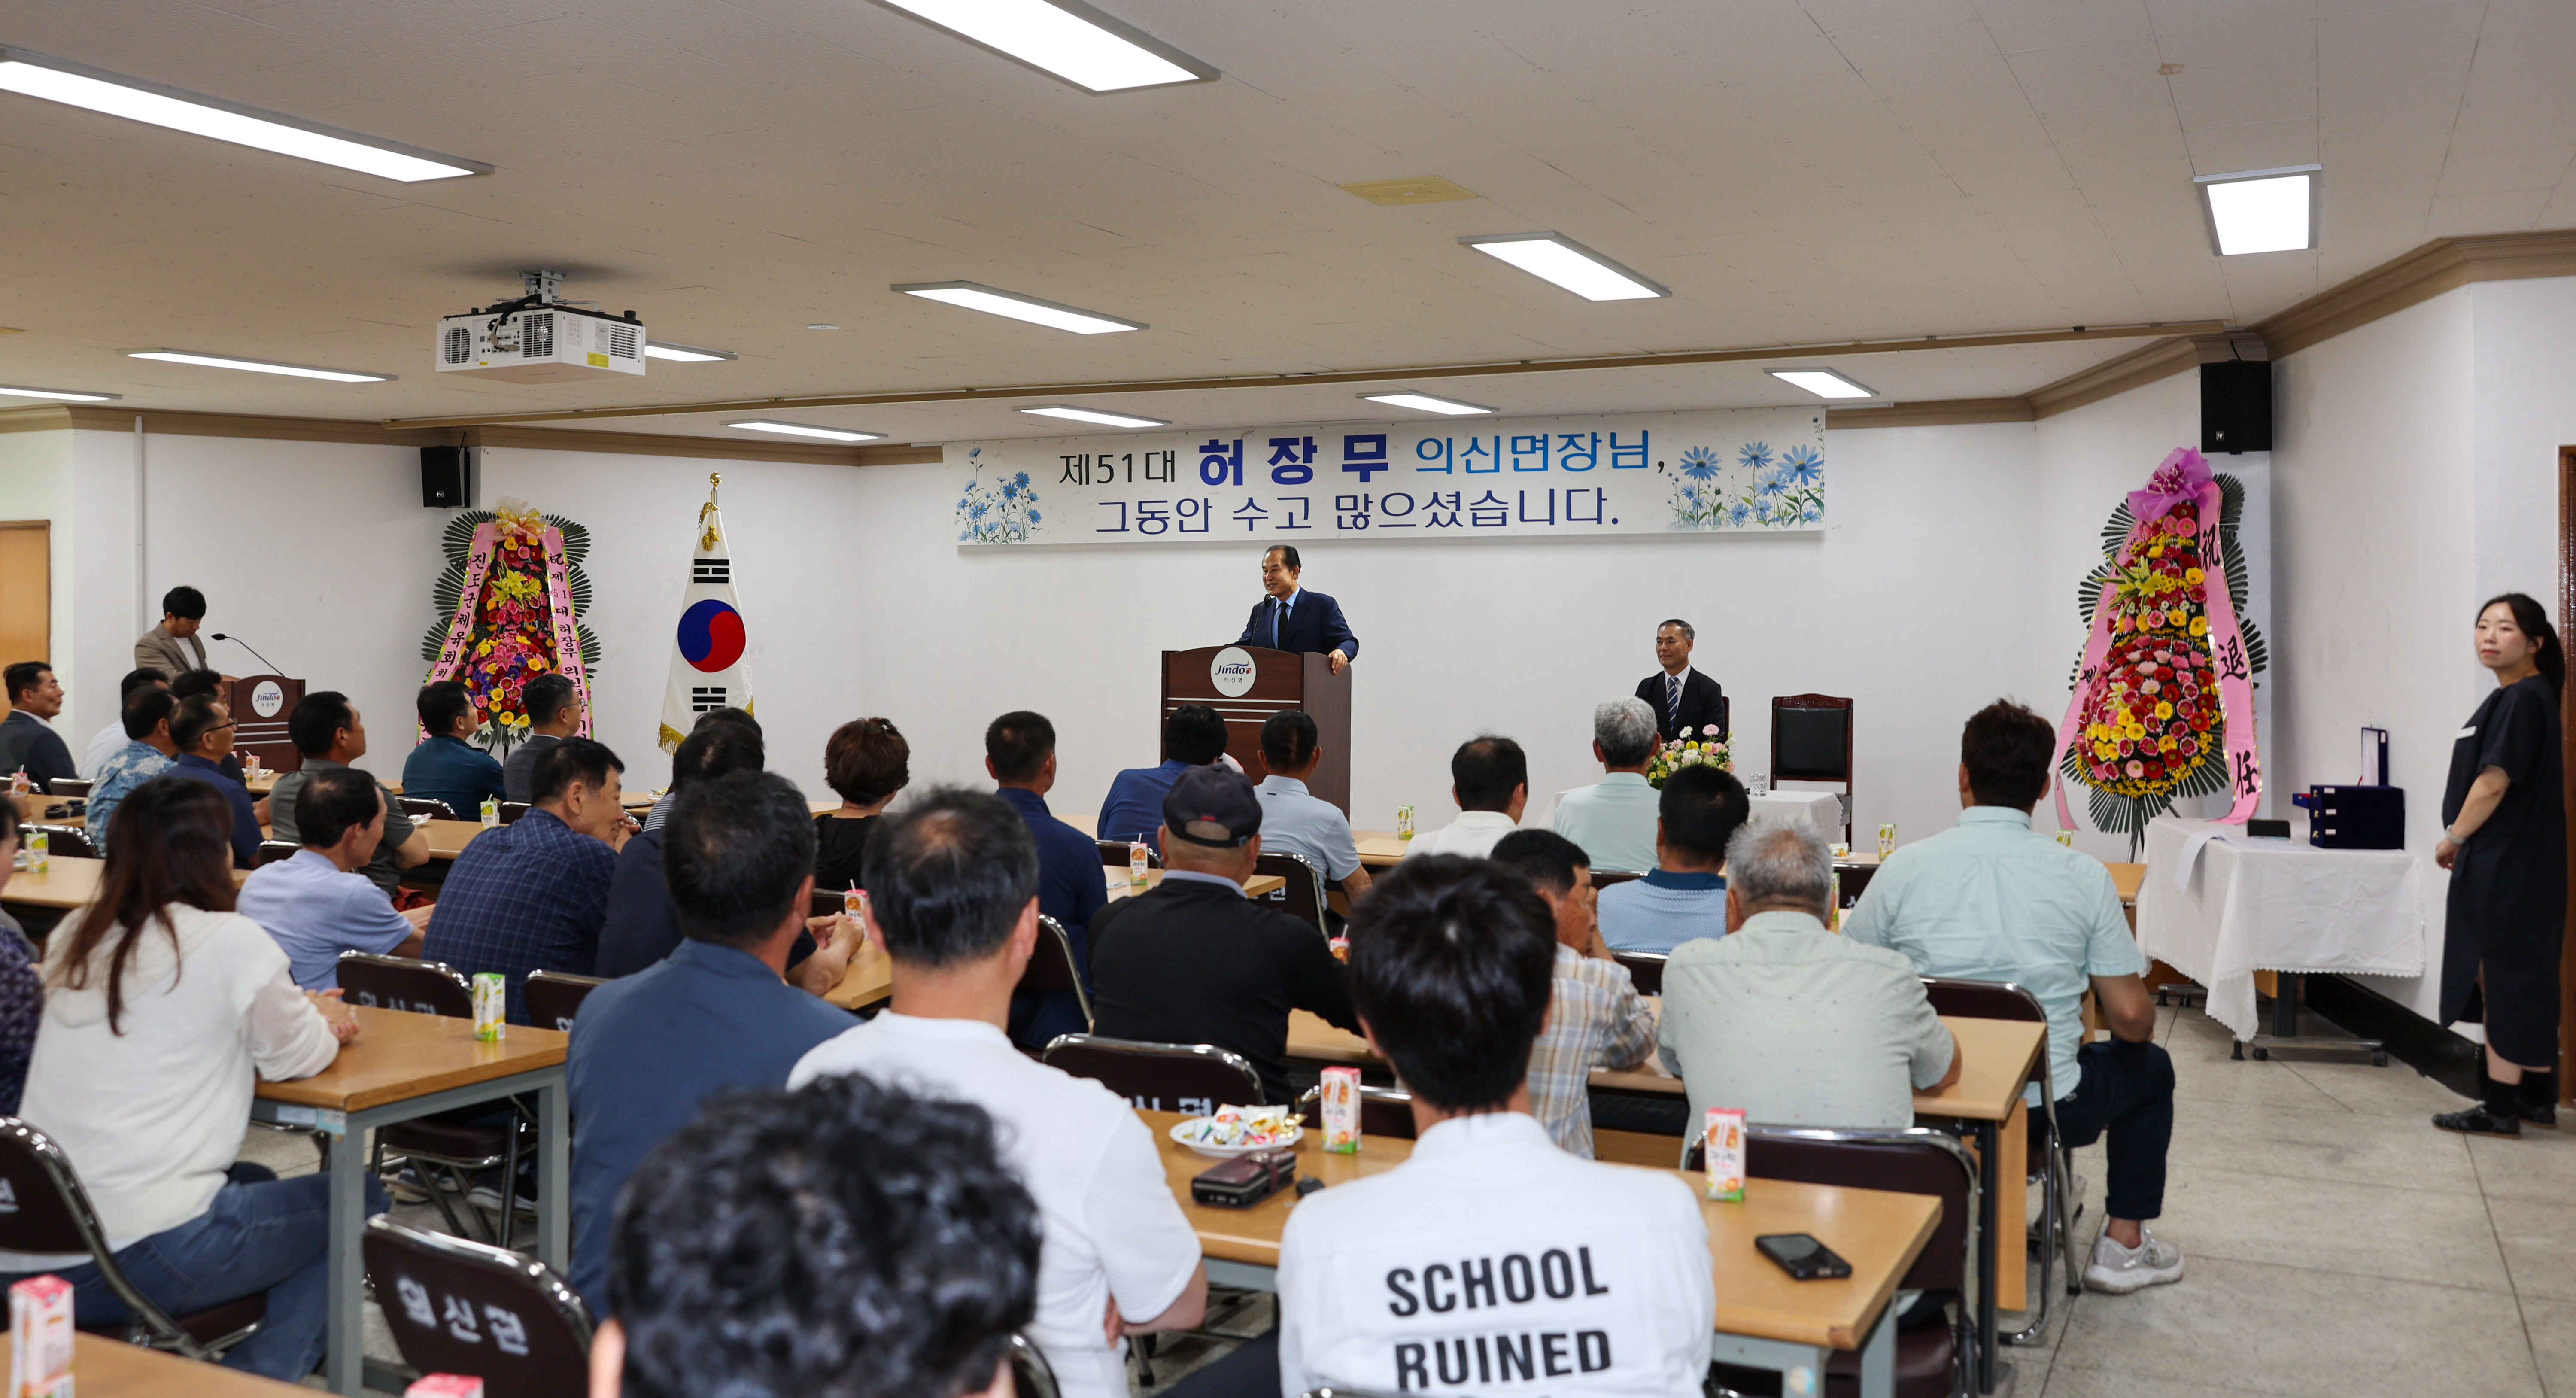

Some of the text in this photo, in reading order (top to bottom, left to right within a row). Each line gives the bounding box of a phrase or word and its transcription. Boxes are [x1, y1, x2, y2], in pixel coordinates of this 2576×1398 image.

[1059, 450, 1176, 486] 제51대
[1415, 430, 1665, 474] 의신면장님,
[1095, 487, 1619, 535] 그동안 수고 많으셨습니다.
[1386, 1246, 1609, 1317] SCHOOL
[396, 1276, 530, 1356] 의신면
[1395, 1330, 1612, 1391] RUINED
